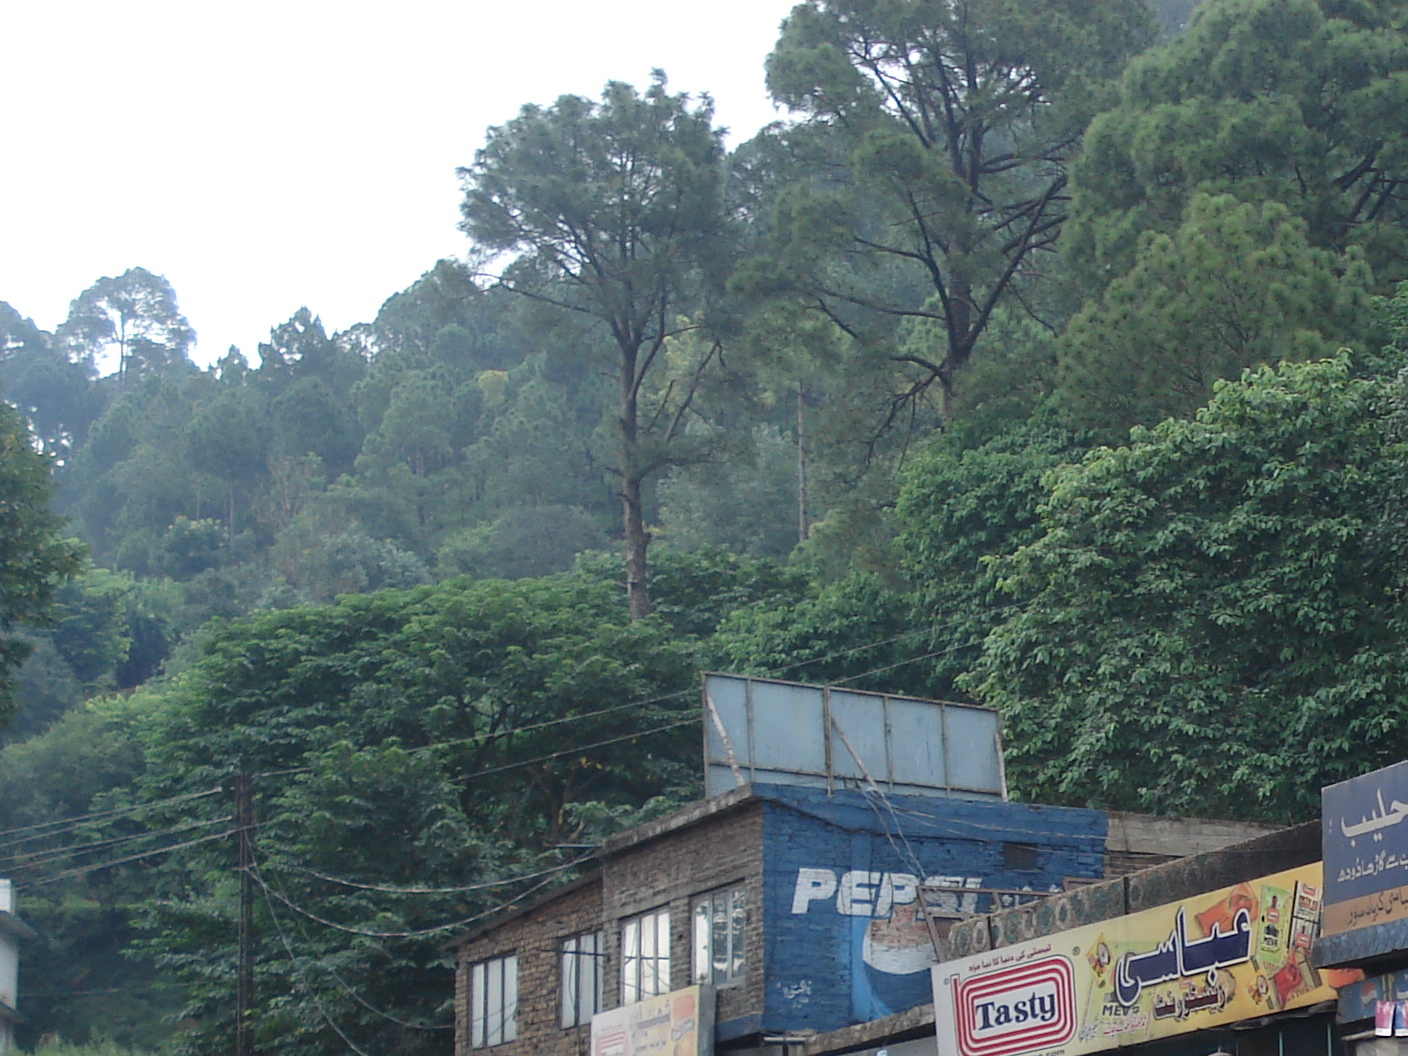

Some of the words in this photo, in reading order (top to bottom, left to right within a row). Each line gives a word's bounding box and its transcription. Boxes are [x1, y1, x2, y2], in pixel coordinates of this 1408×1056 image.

[791, 868, 983, 925] PEPSI
[1115, 906, 1252, 1007] عباسی
[975, 992, 1056, 1031] Tasty
